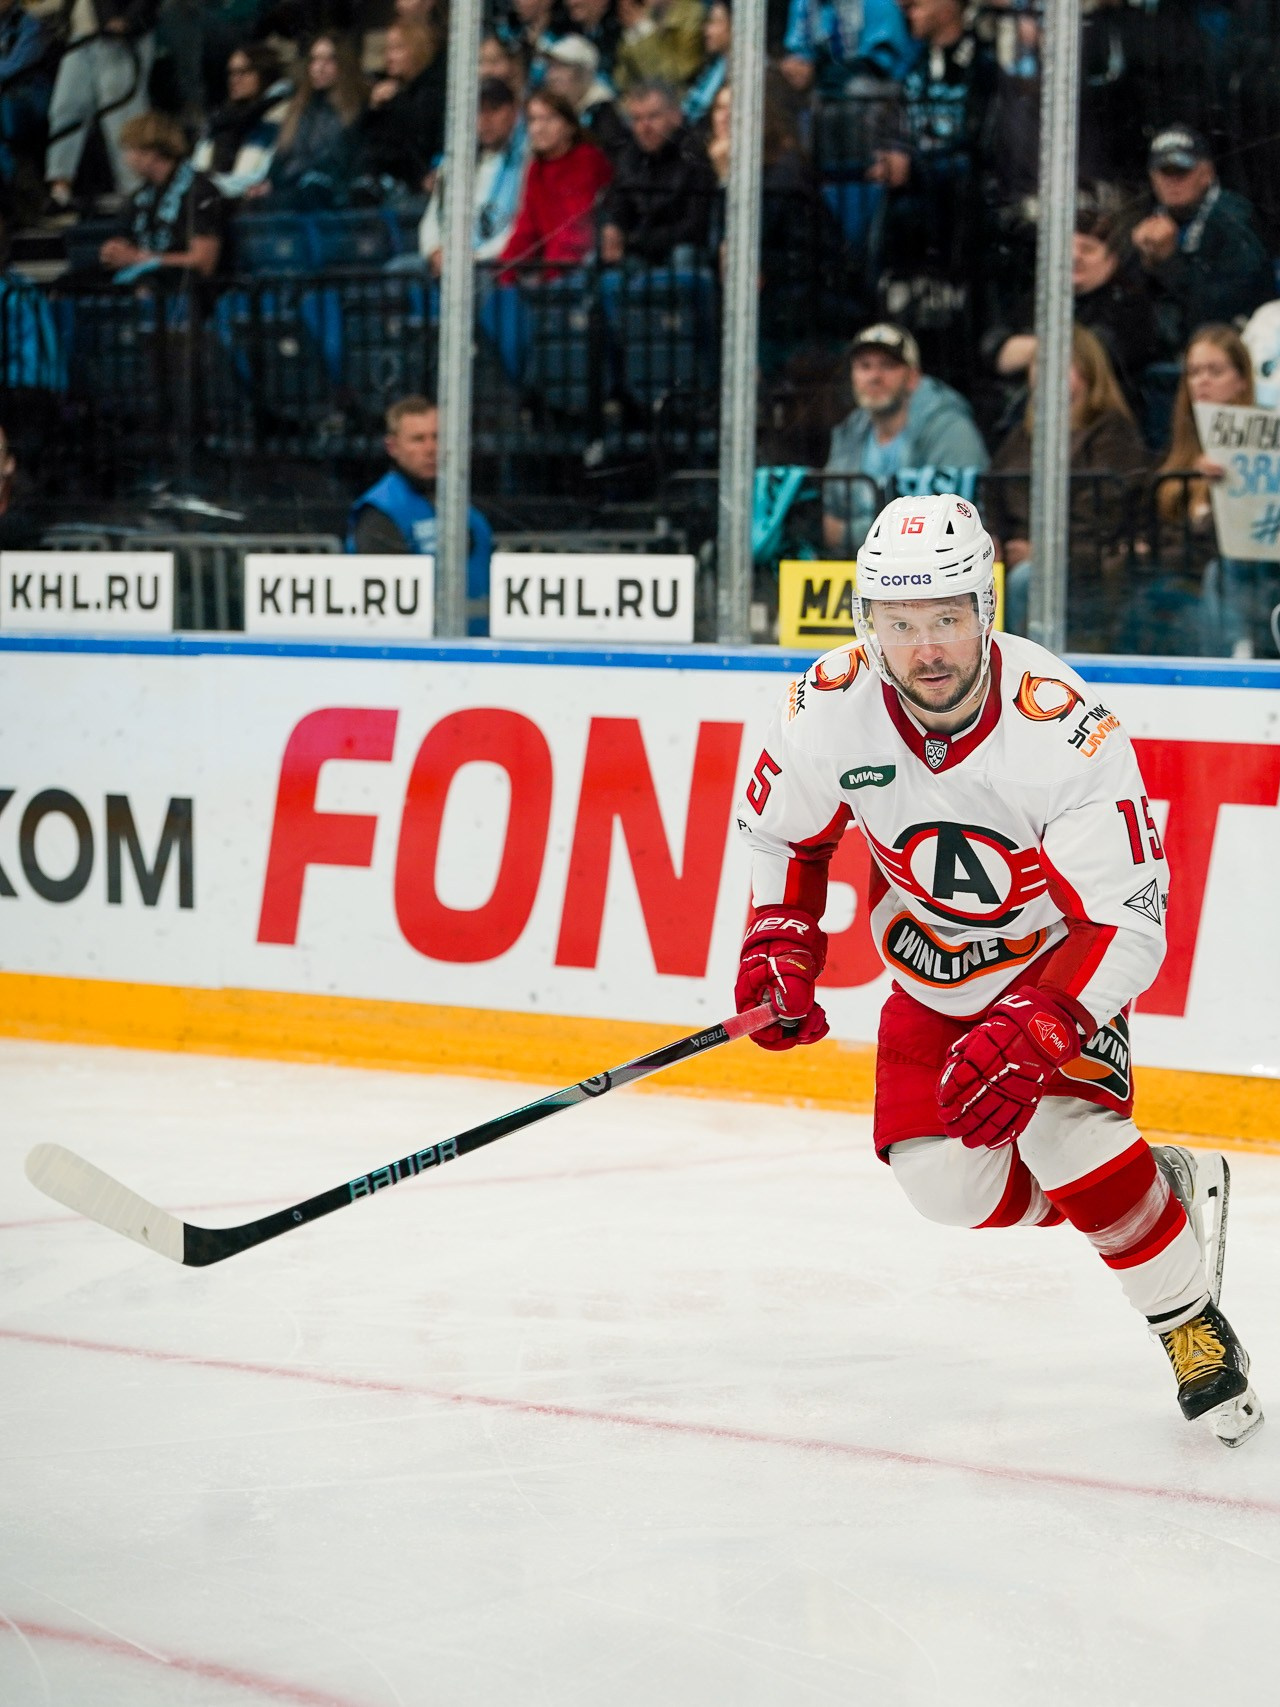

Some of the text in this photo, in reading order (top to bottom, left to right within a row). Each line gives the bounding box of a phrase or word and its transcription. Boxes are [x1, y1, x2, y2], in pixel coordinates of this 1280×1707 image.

[901, 516, 926, 535] 15
[11, 573, 160, 611] KHL.RU
[260, 576, 420, 616] KHL.RU
[505, 576, 680, 619] KHL.RU
[746, 748, 783, 816] 5
[0, 787, 195, 909] ОМ
[1115, 795, 1165, 866] 15
[743, 916, 811, 943] UER
[893, 924, 1000, 981] WINLINE
[700, 1027, 728, 1046] BAUE
[349, 1136, 461, 1203] BAUER
